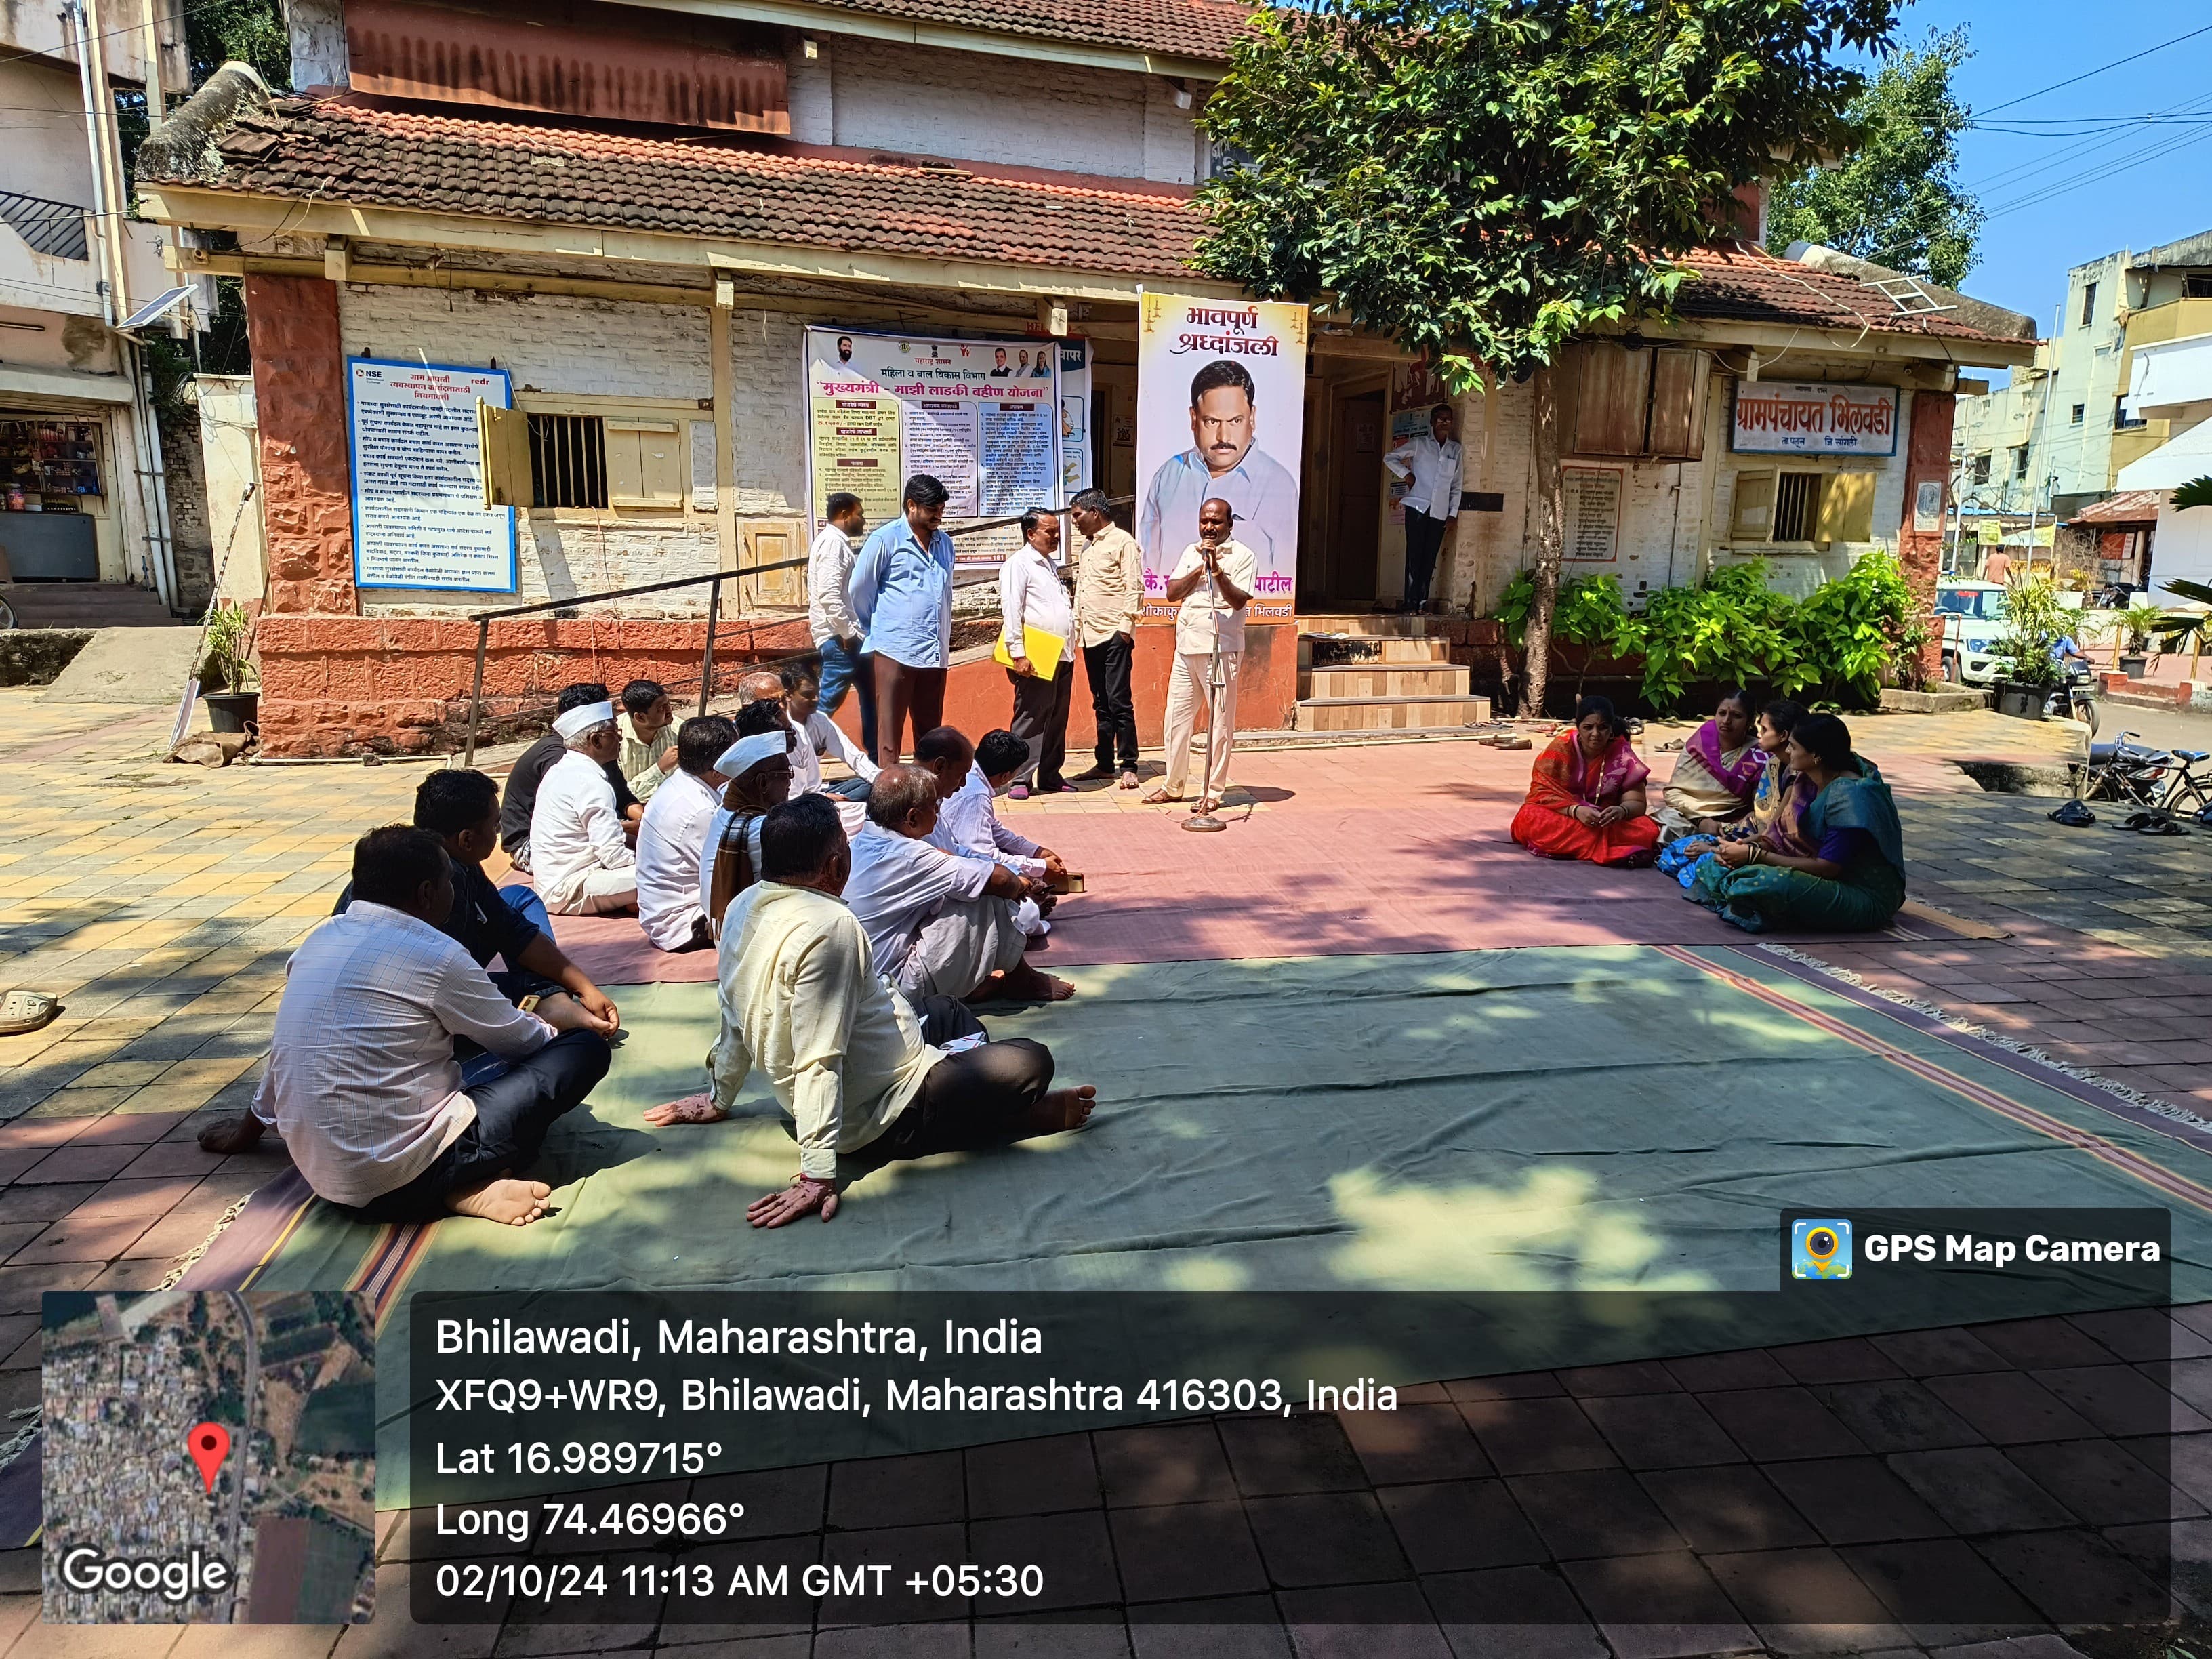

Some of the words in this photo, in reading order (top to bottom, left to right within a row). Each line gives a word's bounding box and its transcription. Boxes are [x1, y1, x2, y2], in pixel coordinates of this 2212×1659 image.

[1187, 306, 1258, 335] भावपूर्ण
[914, 358, 934, 366] महाराष्ट्र
[881, 366, 905, 378] महिला
[916, 370, 933, 378] बाल
[935, 368, 960, 380] विकास
[963, 369, 985, 380] विभाग
[390, 381, 426, 390] व्यवस्थापन
[895, 384, 926, 395] माझी
[928, 384, 968, 396] लाडकी
[972, 385, 1004, 398] बहीण
[1737, 392, 1826, 433] ग्रामपंचायत
[1829, 394, 1893, 435] भिलवडी
[1143, 568, 1163, 591] कै.
[1256, 571, 1292, 592] पाटील
[1141, 602, 1180, 621] शोकाकु
[1254, 603, 1292, 617] भिलवडी
